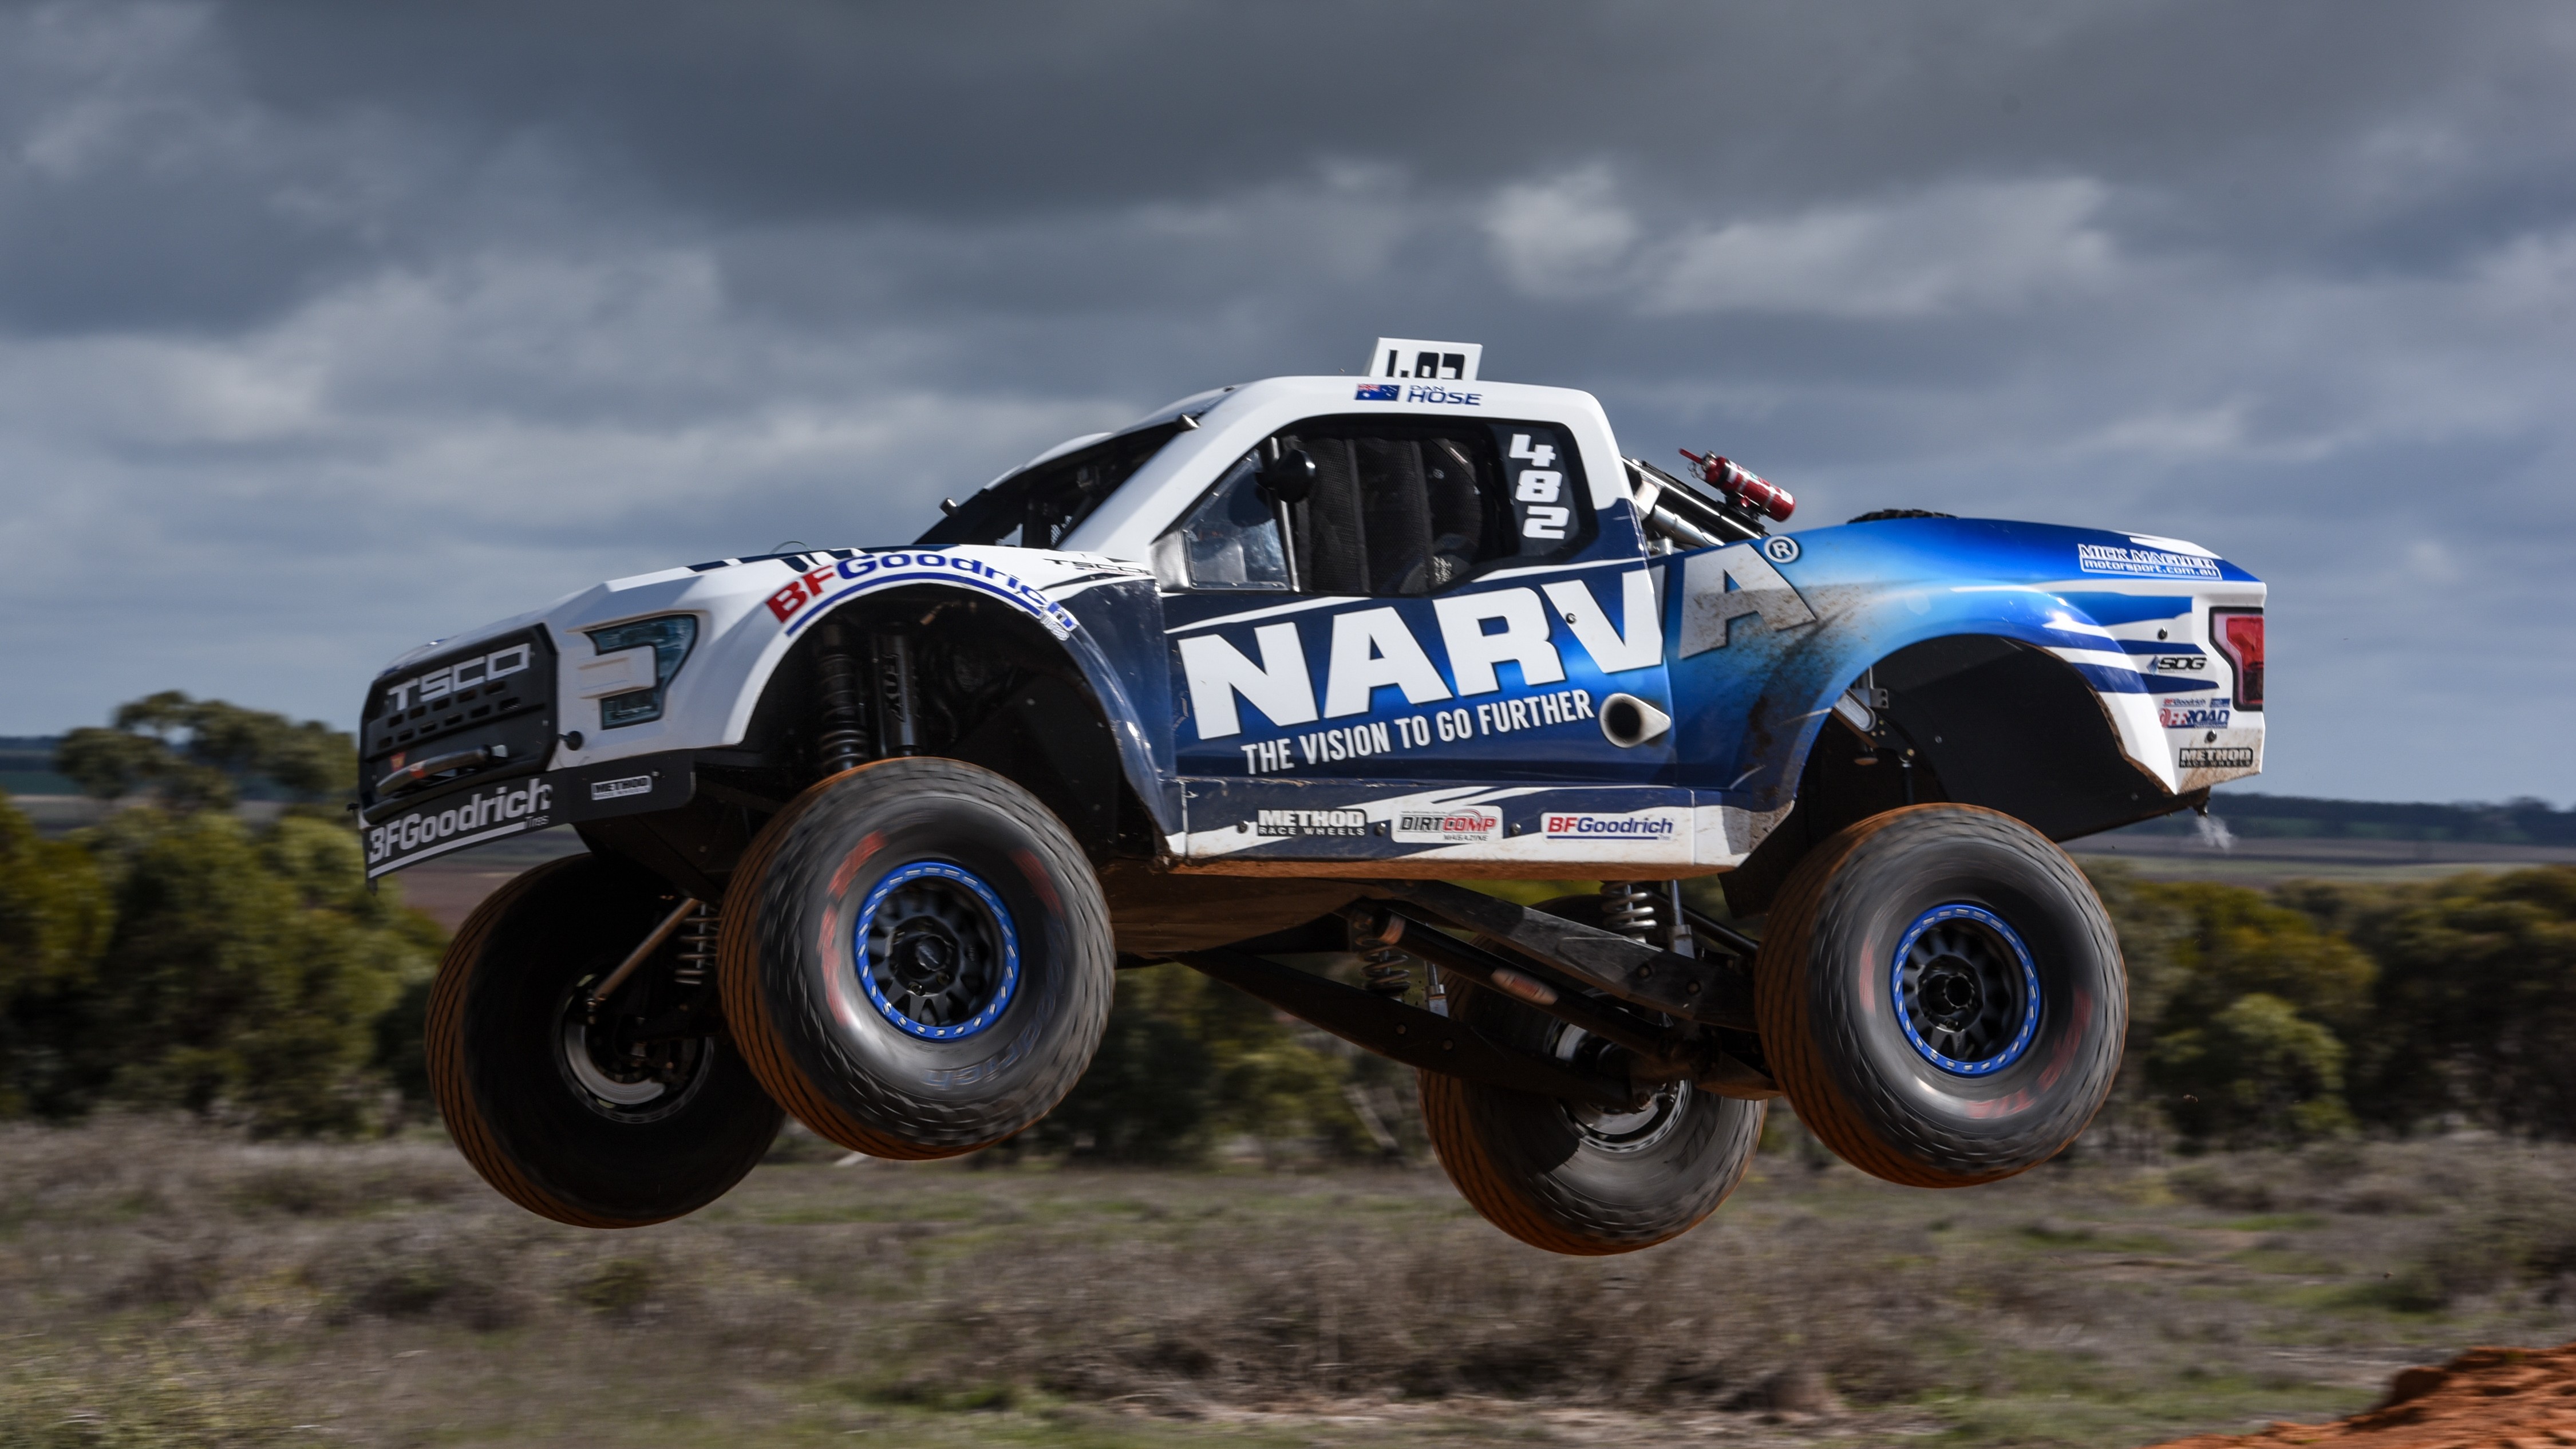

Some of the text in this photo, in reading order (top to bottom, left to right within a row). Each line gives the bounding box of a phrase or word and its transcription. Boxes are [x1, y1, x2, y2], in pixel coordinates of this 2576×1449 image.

[1406, 390, 1483, 406] HOSE
[1509, 433, 1570, 539] 482
[2084, 558, 2218, 577] motorsport.com.au
[2158, 657, 2207, 670] SDG
[388, 643, 531, 711] TSCO
[1241, 689, 1595, 775] THE VISION TO GO FURTHER
[2181, 749, 2251, 761] METHOD
[1259, 810, 1366, 827] METHOD
[1547, 816, 1673, 833] BFGoodrich
[1259, 827, 1365, 835] RACE WHEELS
